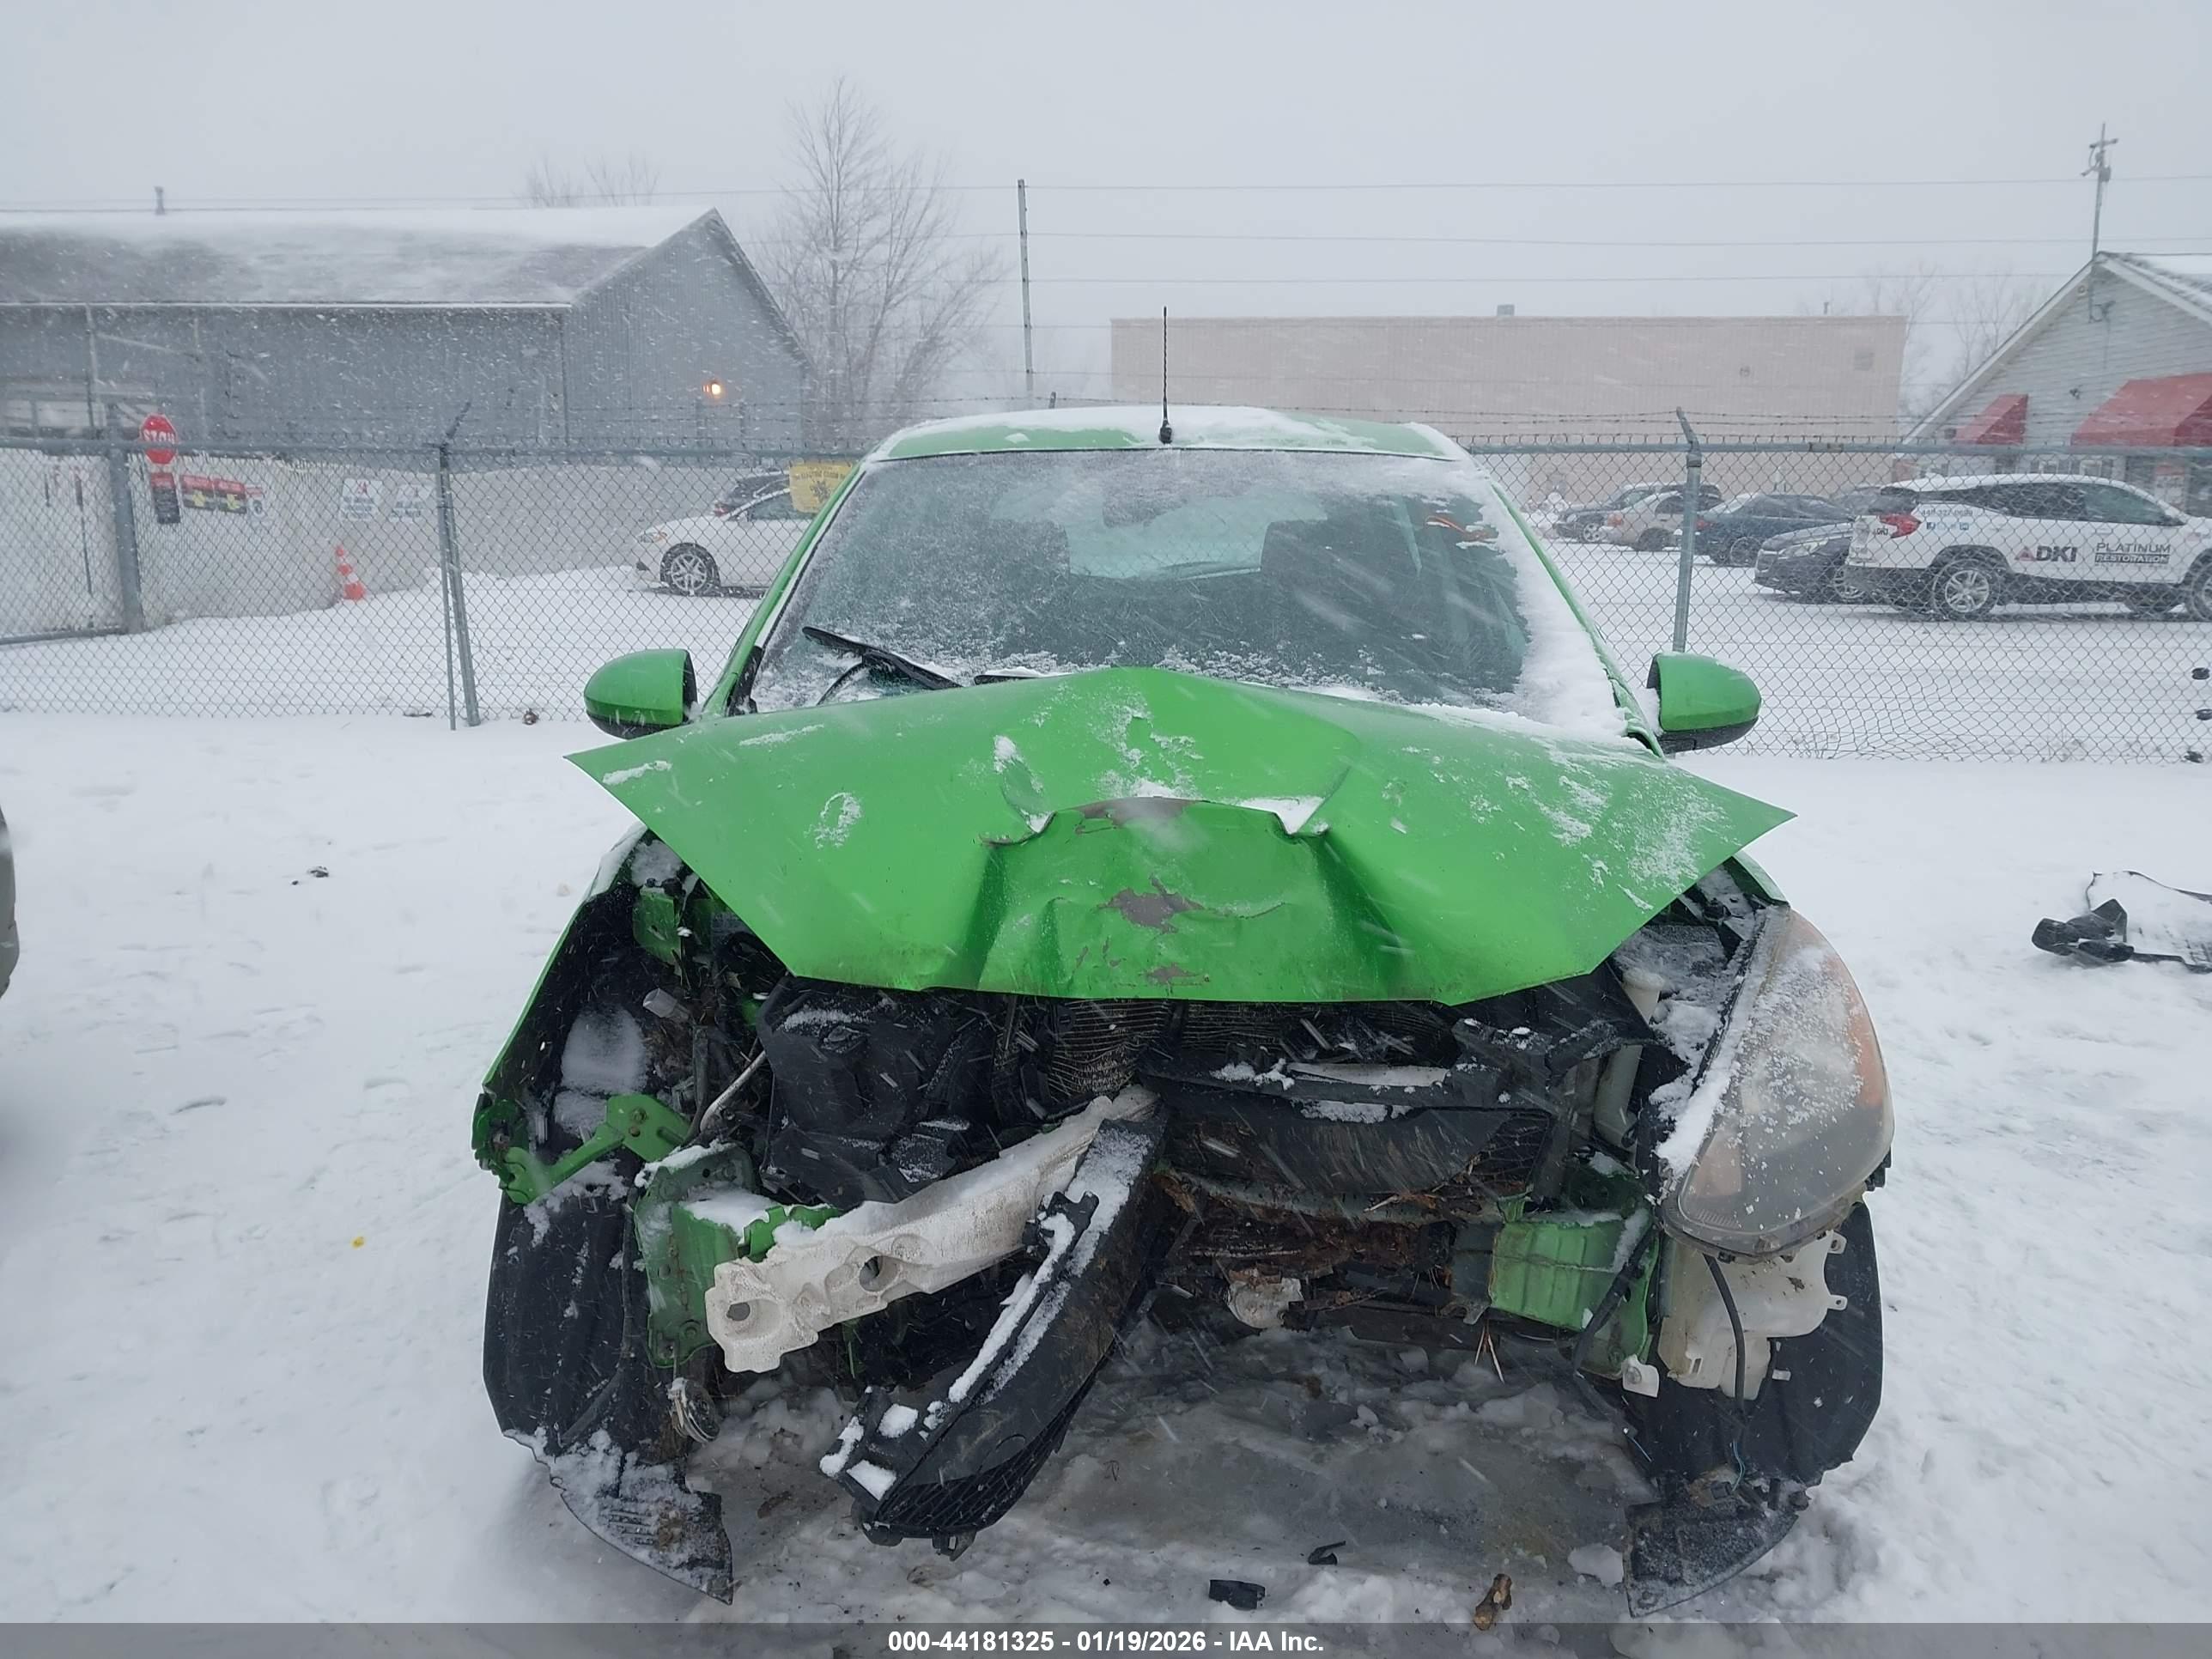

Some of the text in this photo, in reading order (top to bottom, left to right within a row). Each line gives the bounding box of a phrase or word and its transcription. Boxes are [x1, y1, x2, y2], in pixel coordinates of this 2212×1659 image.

[143, 429, 175, 445] STOP
[2096, 543, 2171, 553] PLATINUM
[2096, 554, 2170, 563] RESTORATION
